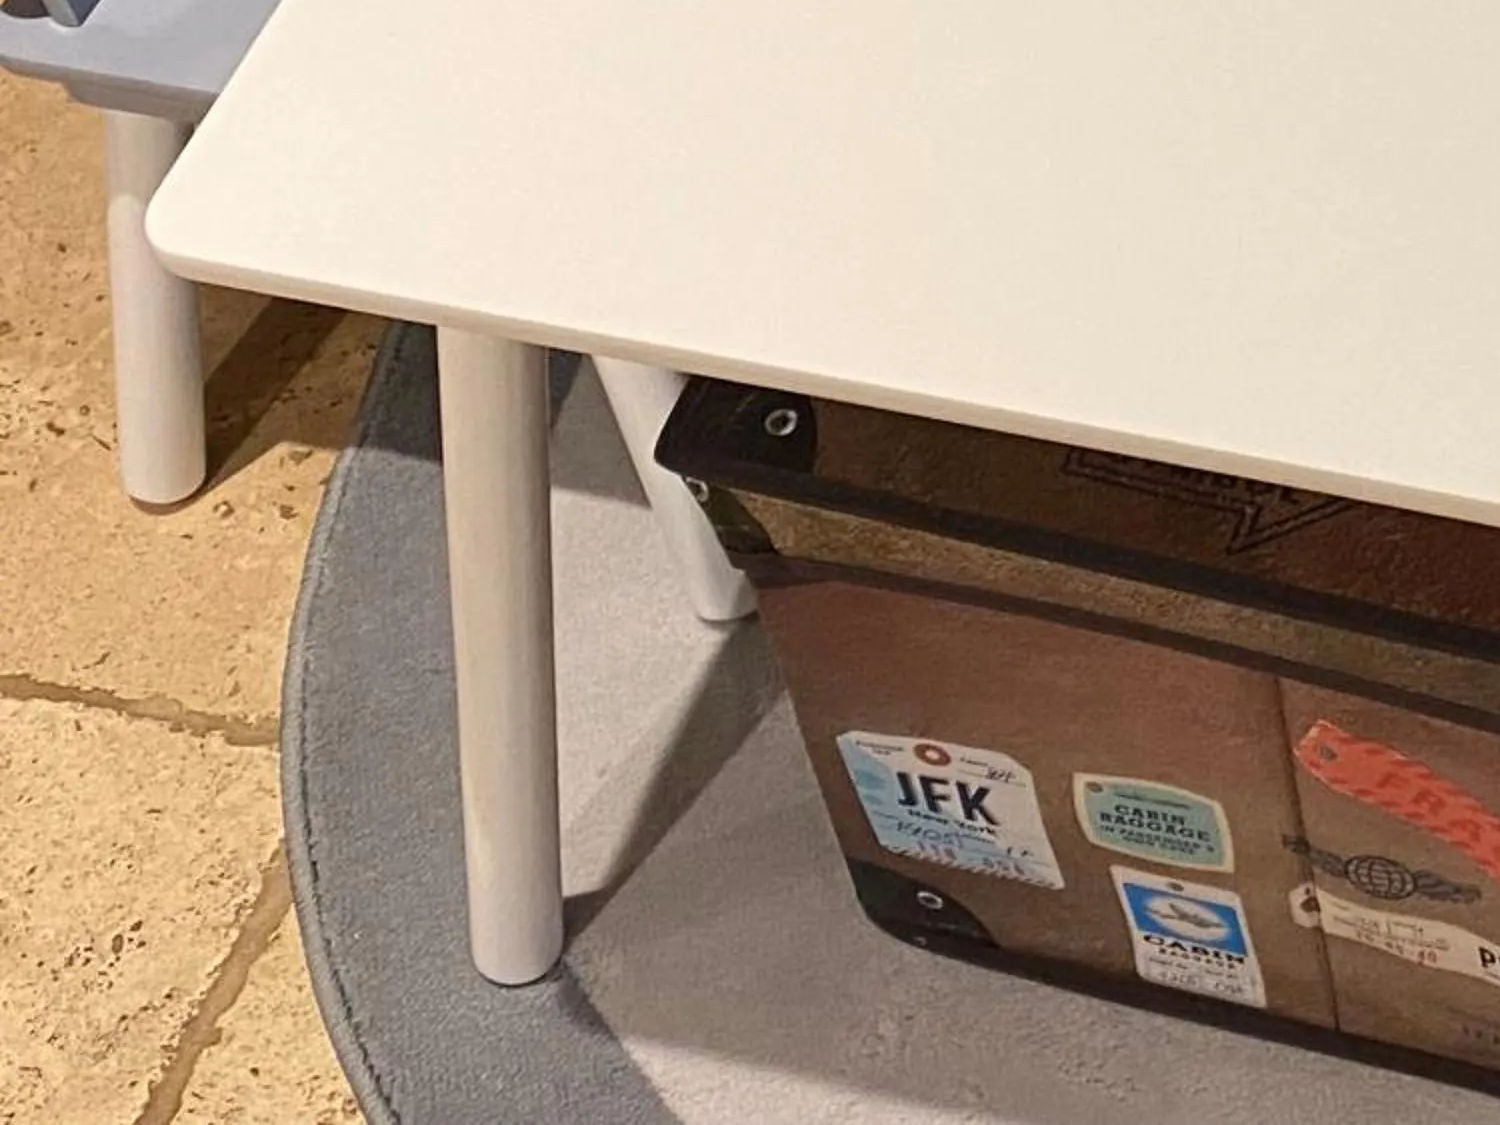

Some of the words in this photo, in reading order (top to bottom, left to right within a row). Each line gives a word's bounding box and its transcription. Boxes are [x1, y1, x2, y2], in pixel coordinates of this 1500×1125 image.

[896, 771, 1001, 827] JFK
[1100, 812, 1212, 841] BAGGAGE
[1114, 804, 1186, 825] CABIN
[1142, 933, 1246, 965] CABIN
